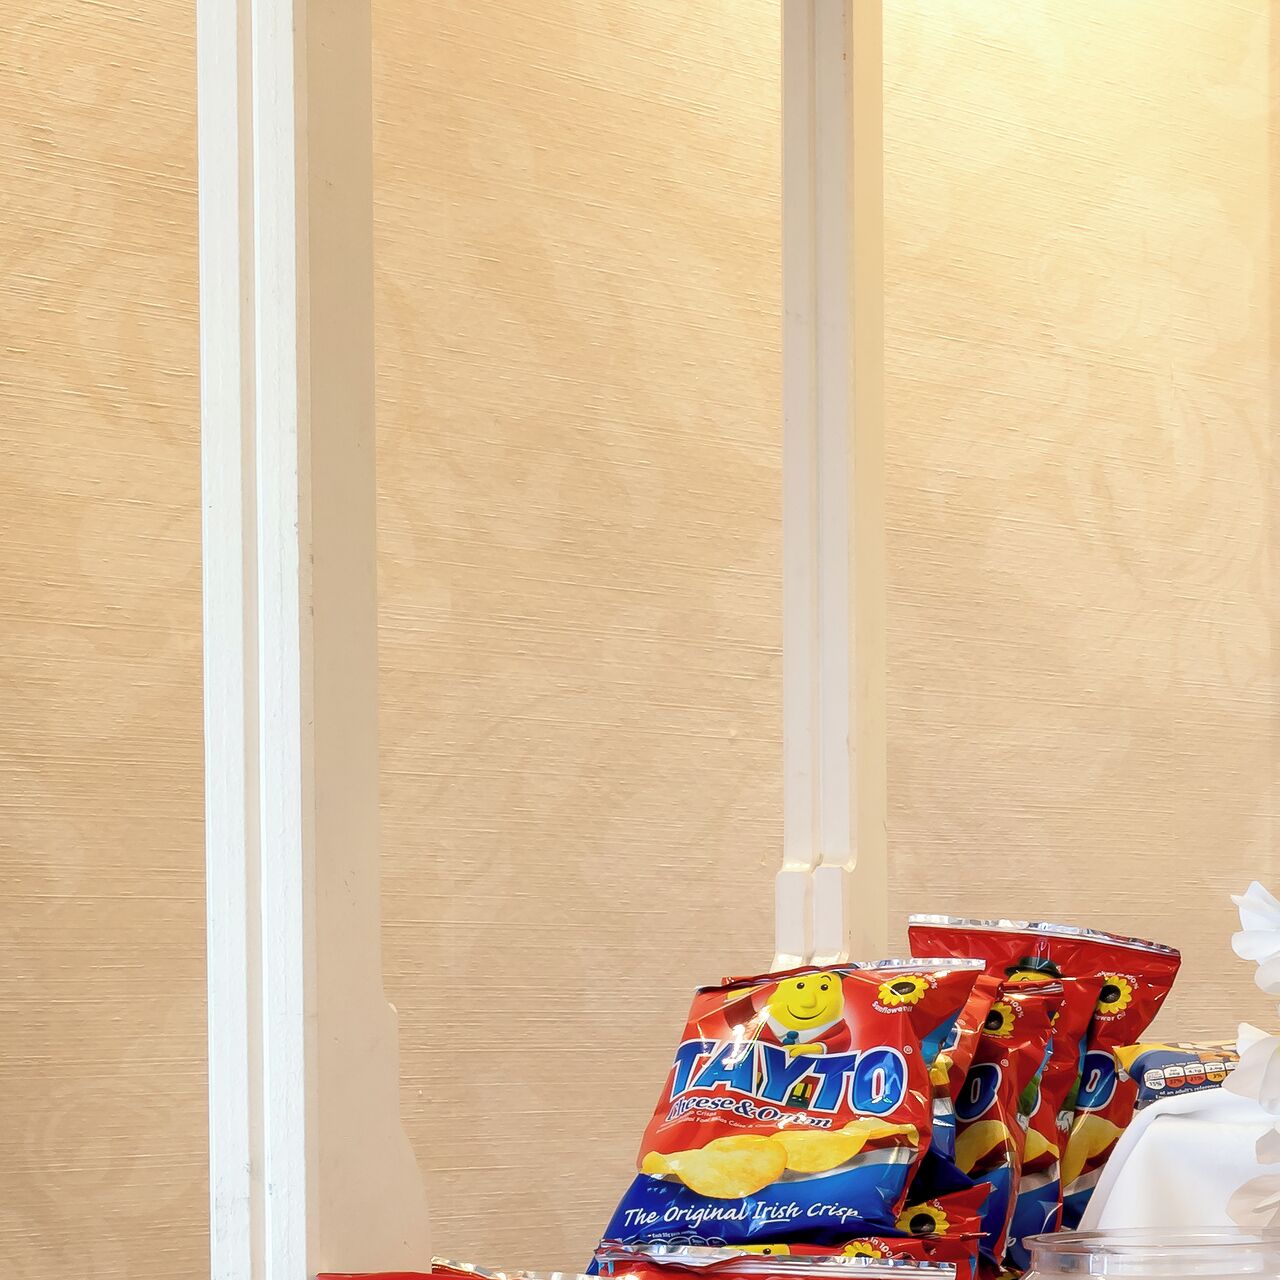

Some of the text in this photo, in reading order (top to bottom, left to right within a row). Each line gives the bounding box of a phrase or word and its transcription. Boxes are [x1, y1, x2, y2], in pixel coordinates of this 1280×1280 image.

[670, 1039, 909, 1116] TAYTO
[624, 1201, 863, 1229] The Original Irish Crisp
